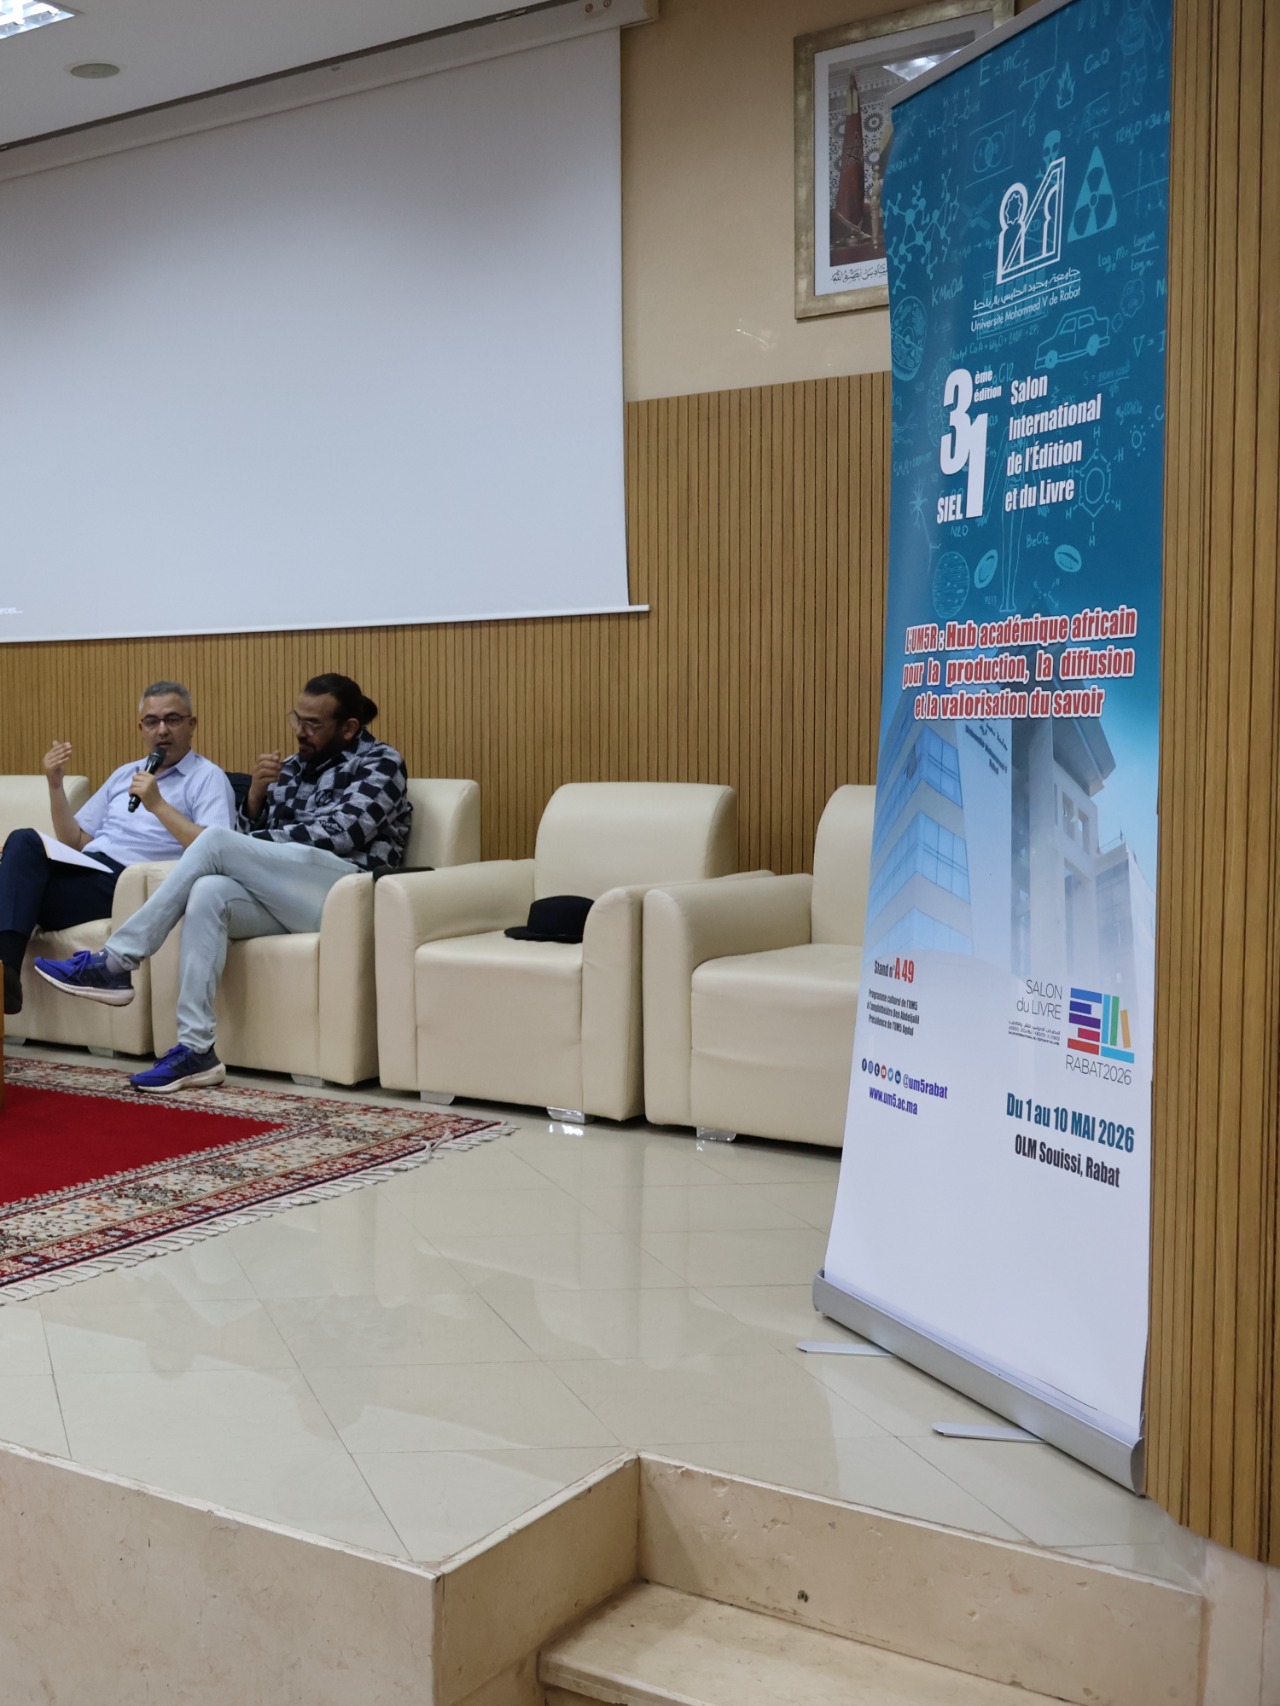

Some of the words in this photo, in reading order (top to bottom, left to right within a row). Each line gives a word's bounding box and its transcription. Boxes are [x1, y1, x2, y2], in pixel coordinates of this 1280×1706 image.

[971, 311, 1004, 332] Université
[1004, 297, 1041, 321] Mohammed
[1041, 295, 1048, 307] V
[1049, 292, 1058, 306] de
[1059, 286, 1081, 302] Rabat
[974, 370, 993, 385] ème
[1010, 375, 1048, 405] Salon
[973, 385, 1002, 403] édition
[1008, 393, 1102, 441] International
[940, 368, 988, 518] 31
[1006, 451, 1022, 477] de
[1024, 439, 1083, 473] l'Édition
[936, 493, 964, 524] SIEL
[1004, 487, 1017, 512] et
[1019, 483, 1037, 509] du
[1039, 478, 1075, 506] Livre
[946, 621, 978, 650] Hub
[980, 613, 1069, 648] académique
[1071, 605, 1138, 641] africain
[902, 662, 924, 689] pour
[927, 657, 940, 685] la
[946, 652, 1029, 687] production,
[1036, 650, 1053, 681] la
[1060, 645, 1135, 679] diffusion
[915, 693, 926, 719] et
[926, 691, 939, 719] la
[941, 689, 1028, 718] valorisation
[1029, 687, 1051, 718] du
[1052, 685, 1105, 717] savoir
[874, 960, 888, 977] Stand
[894, 957, 900, 980] A
[901, 959, 914, 983] 49
[1026, 979, 1062, 1000] SALON
[1017, 997, 1029, 1012] du
[1032, 1000, 1061, 1020] LIVRE
[1065, 1054, 1132, 1085] RABAT2026
[869, 1086, 918, 1115] www.um5.ac.ma
[903, 1073, 948, 1099] @um5rabat
[1007, 1092, 1023, 1119] Du
[1026, 1098, 1032, 1122] 1
[1034, 1104, 1051, 1128] au
[1053, 1106, 1068, 1133] 10
[1071, 1110, 1096, 1141] MAI
[1098, 1118, 1135, 1153] 2026
[1015, 1133, 1038, 1160] OLM
[1039, 1140, 1083, 1178] Souissi,
[1085, 1156, 1120, 1188] Rabat
